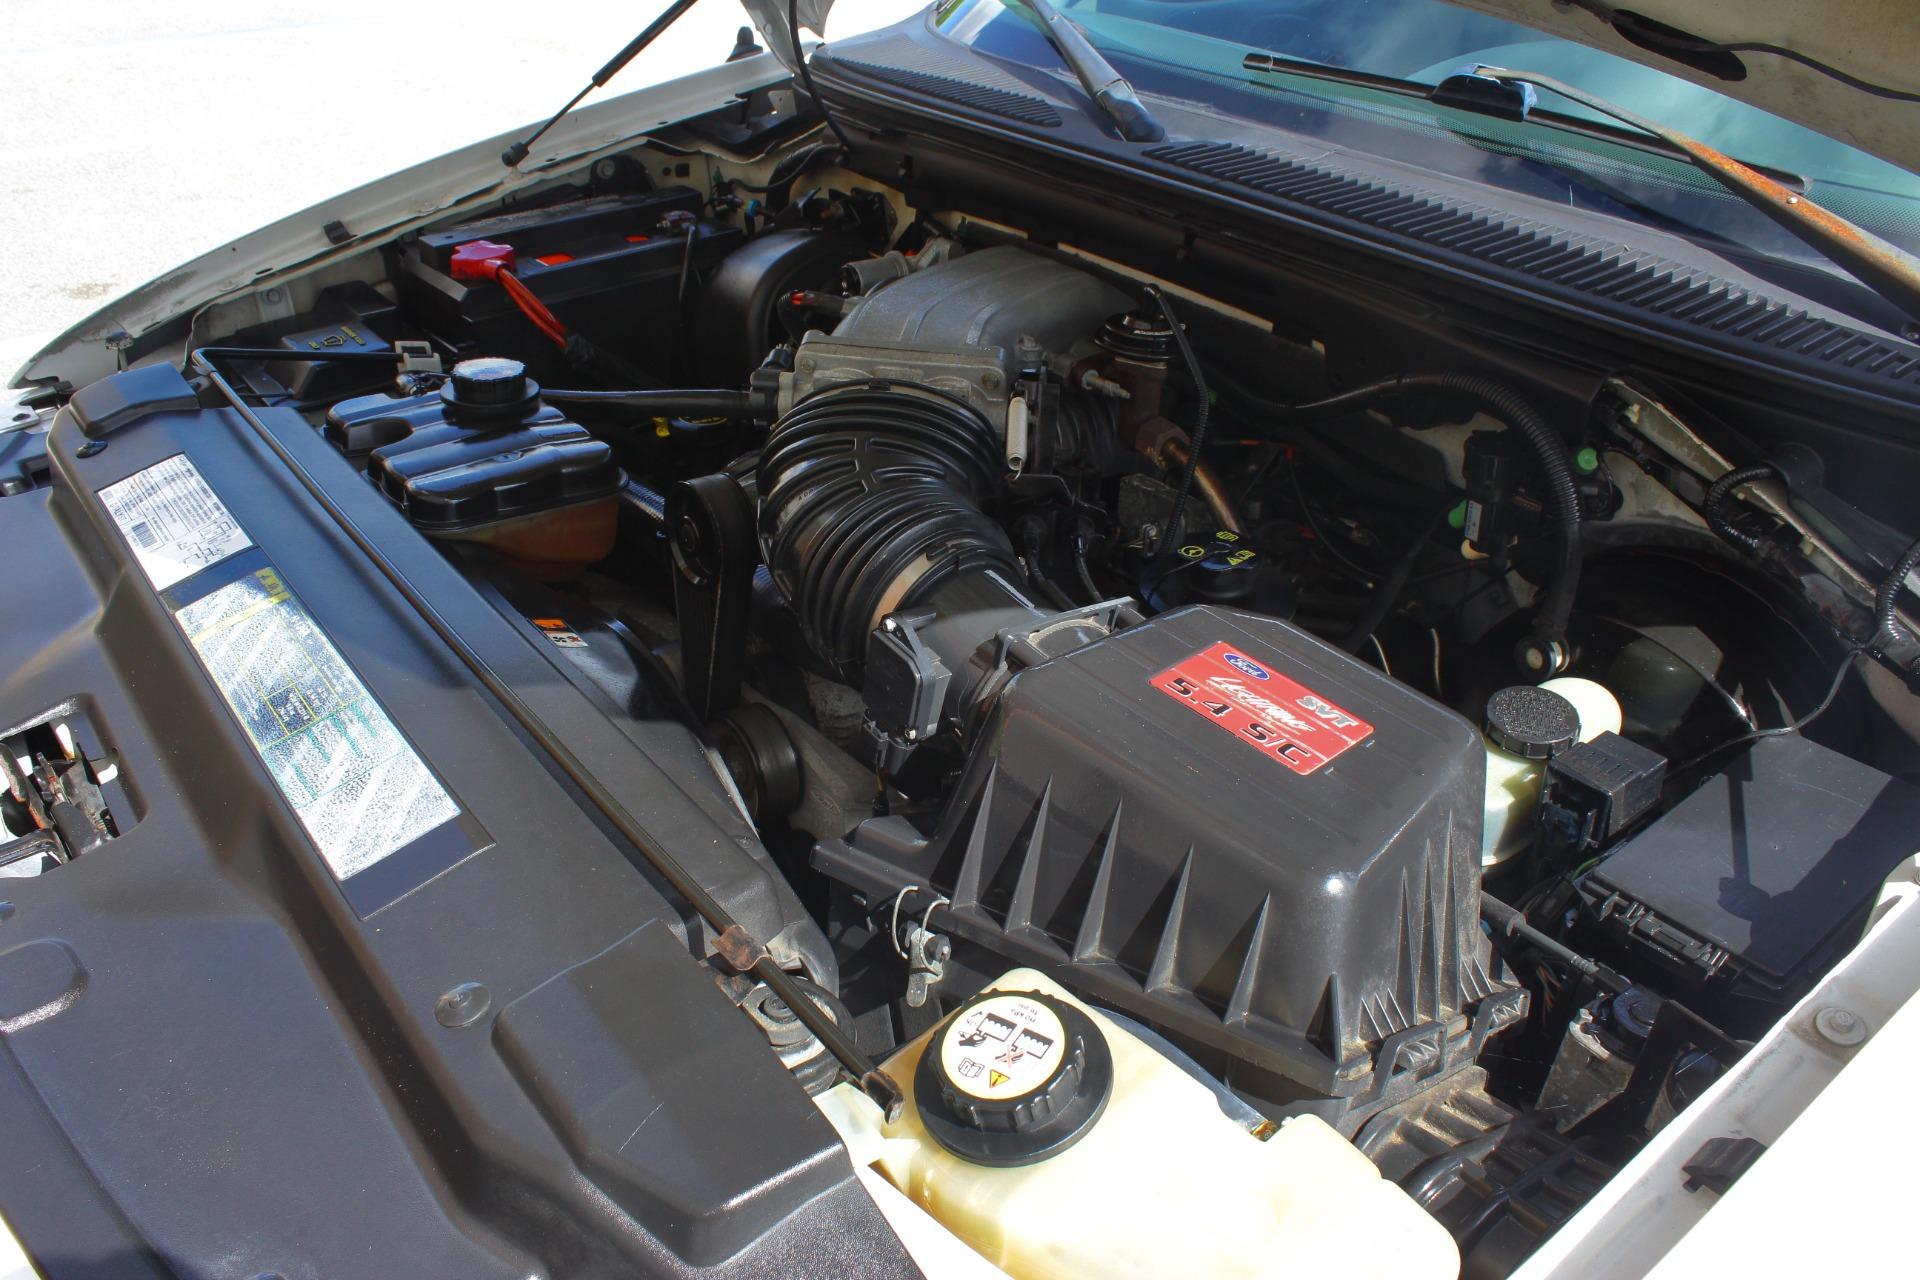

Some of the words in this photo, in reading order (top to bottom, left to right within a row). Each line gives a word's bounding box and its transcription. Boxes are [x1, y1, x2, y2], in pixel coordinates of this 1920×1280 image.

[1228, 655, 1265, 677] Ford
[1164, 678, 1232, 716] 5.4
[1240, 723, 1311, 766] S/C
[1296, 696, 1358, 728] SVT
